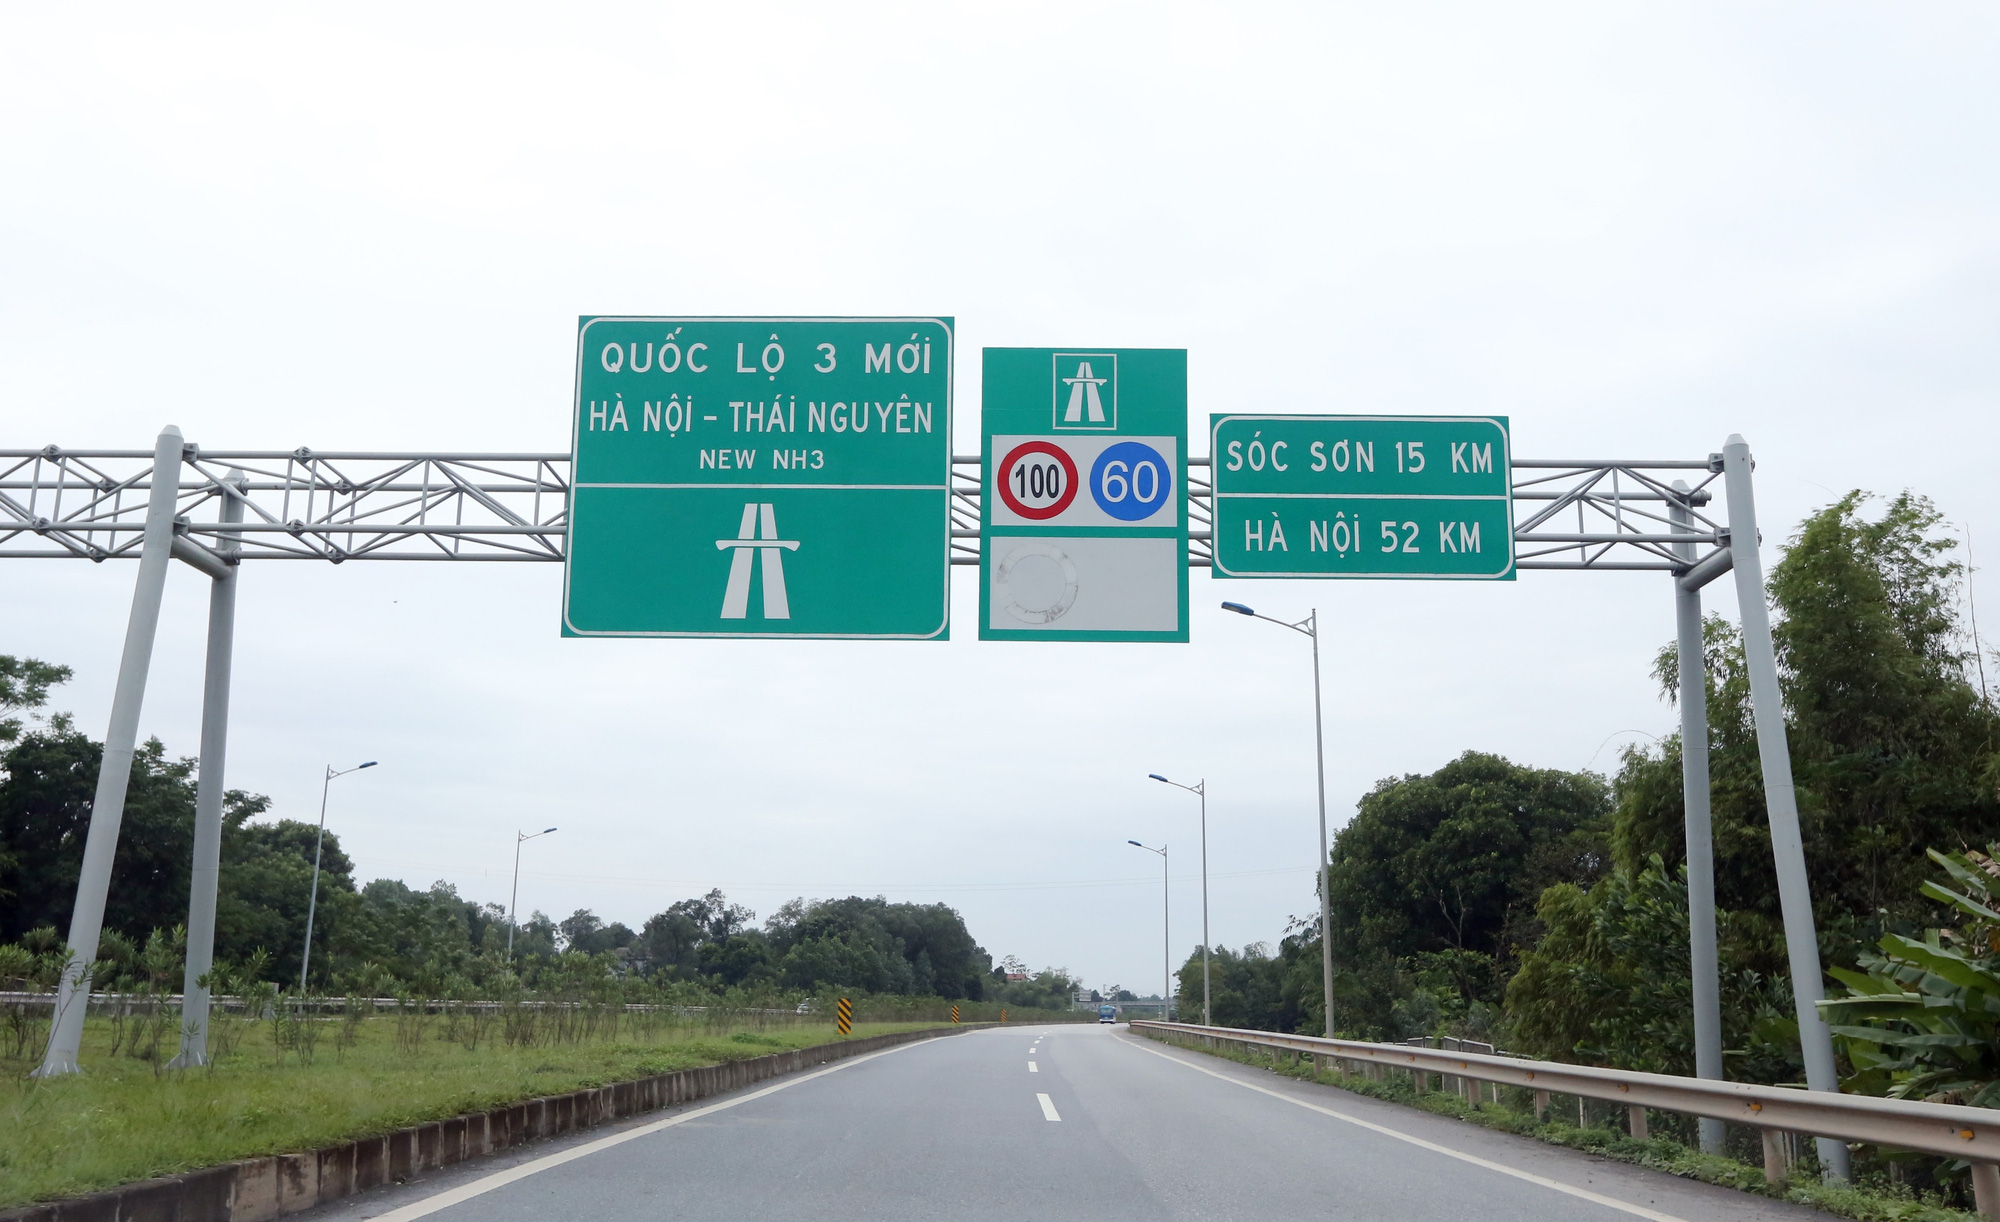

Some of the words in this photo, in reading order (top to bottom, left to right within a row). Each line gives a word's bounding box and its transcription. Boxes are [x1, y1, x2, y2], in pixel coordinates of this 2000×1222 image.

[602, 327, 707, 373] QUỐC
[737, 334, 784, 381] LỘ
[814, 343, 836, 373] 3
[590, 393, 628, 431] HÀ
[809, 394, 931, 433] NGUYÊN
[700, 450, 756, 469] NEW
[774, 450, 824, 469] NH3
[1227, 431, 1288, 471] SÓC
[1311, 440, 1373, 472] SƠN
[1396, 442, 1425, 473] 15
[1452, 443, 1492, 473] KM
[1016, 464, 1059, 498] 100
[1102, 461, 1158, 502] 60
[1246, 512, 1287, 551] HÀ
[1381, 521, 1419, 552] 52
[1440, 522, 1480, 553] KM
